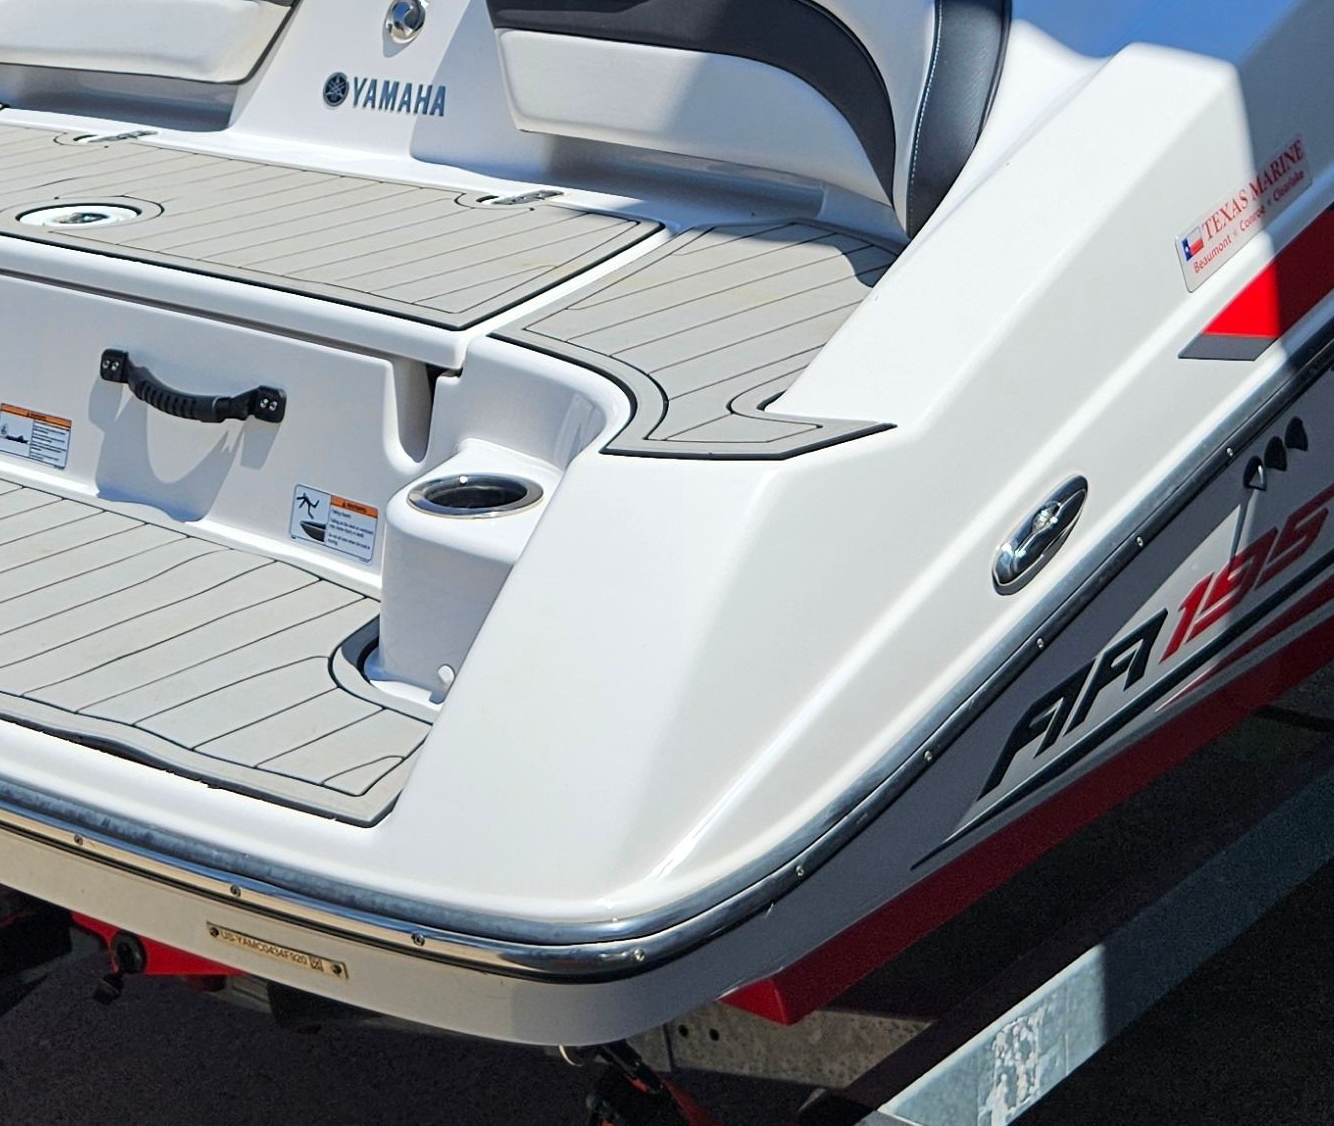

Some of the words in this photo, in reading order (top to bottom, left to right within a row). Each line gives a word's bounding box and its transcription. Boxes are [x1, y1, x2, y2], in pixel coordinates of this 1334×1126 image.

[352, 76, 447, 117] YAMAHA
[1193, 234, 1233, 274] Beaumont
[1239, 204, 1266, 232] Conroe
[1273, 169, 1305, 202] Clearlake
[1201, 188, 1249, 241] TEXAS
[1248, 138, 1304, 201] MARINE
